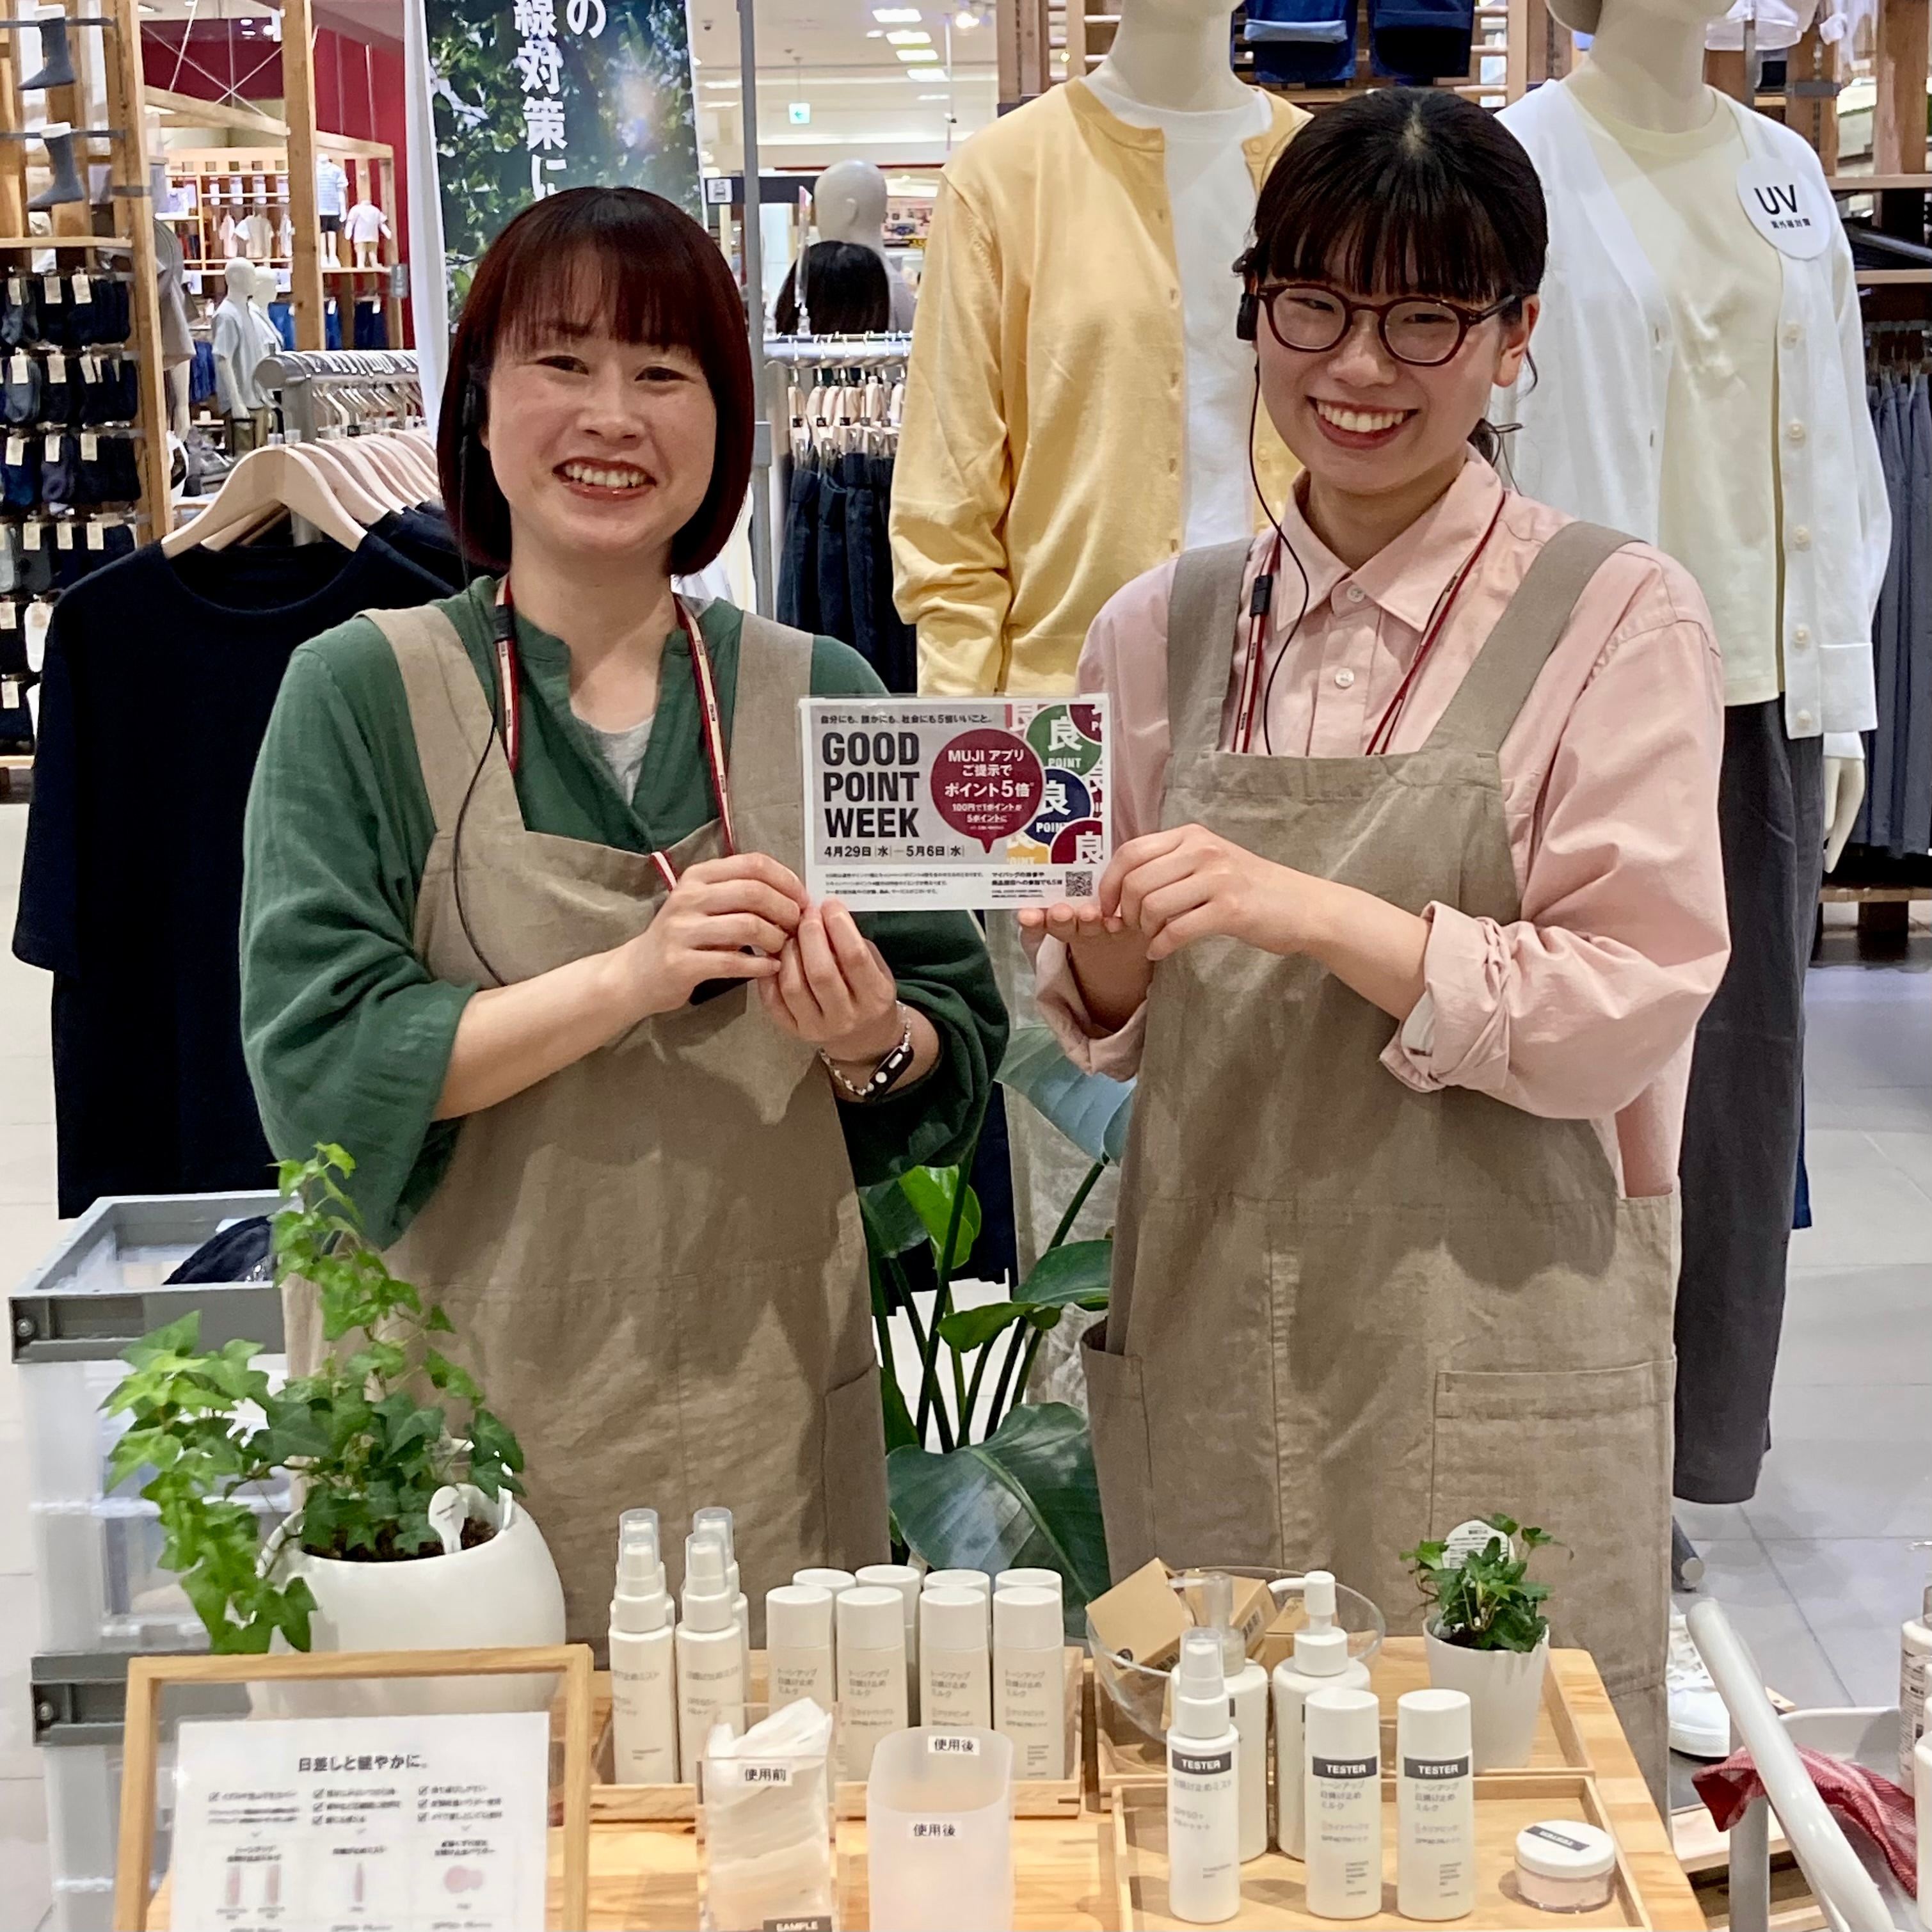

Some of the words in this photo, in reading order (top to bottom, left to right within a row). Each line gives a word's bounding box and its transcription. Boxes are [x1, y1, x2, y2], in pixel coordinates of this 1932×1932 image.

[1753, 184, 1798, 215] UV
[1048, 716, 1083, 752] 良
[822, 731, 920, 766] GOOD
[948, 749, 984, 762] MUJI
[989, 749, 1025, 762] アプリ
[962, 764, 1013, 777] ご提示で
[1048, 758, 1082, 769] POINT
[824, 771, 920, 802] POINT
[824, 808, 920, 838] WEEK
[934, 1738, 973, 1752] 使用後
[1181, 1759, 1220, 1770] TESTER
[1325, 1764, 1366, 1775] TESTER
[1417, 1764, 1458, 1775] TESTER
[745, 1768, 787, 1782] 使用前
[914, 1823, 955, 1837] 使用後
